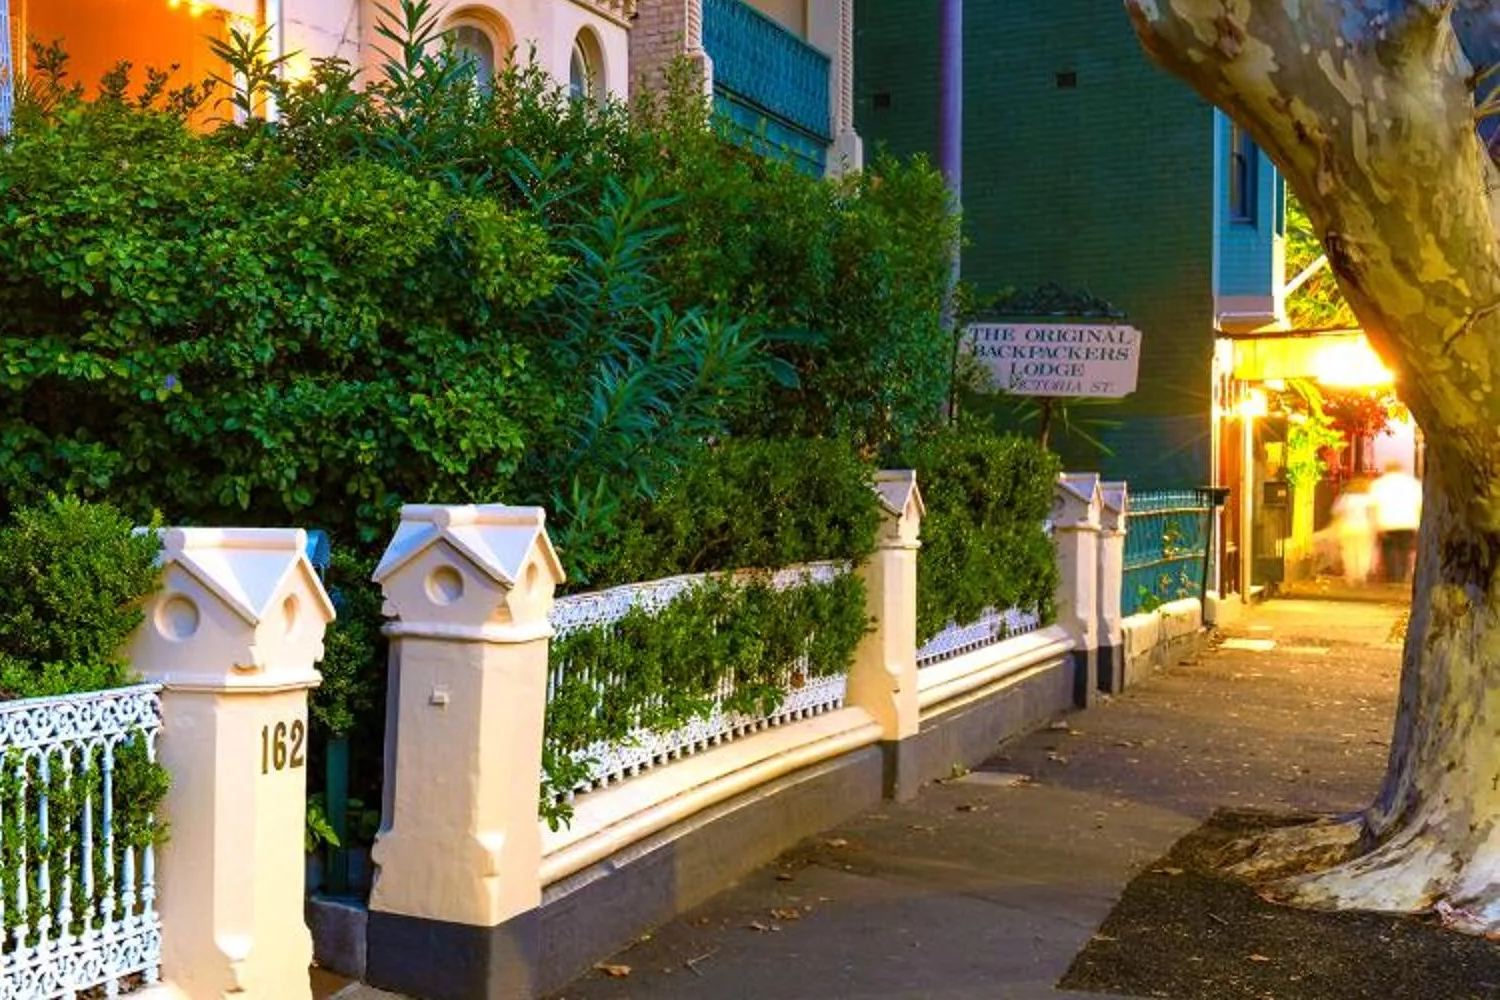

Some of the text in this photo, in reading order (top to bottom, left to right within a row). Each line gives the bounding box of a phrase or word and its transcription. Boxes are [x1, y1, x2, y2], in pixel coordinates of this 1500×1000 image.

[970, 327, 1132, 345] THE ORIGINAL
[973, 344, 1129, 361] BACKPACKERS
[1011, 362, 1085, 378] LODGE
[261, 719, 304, 774] 162
